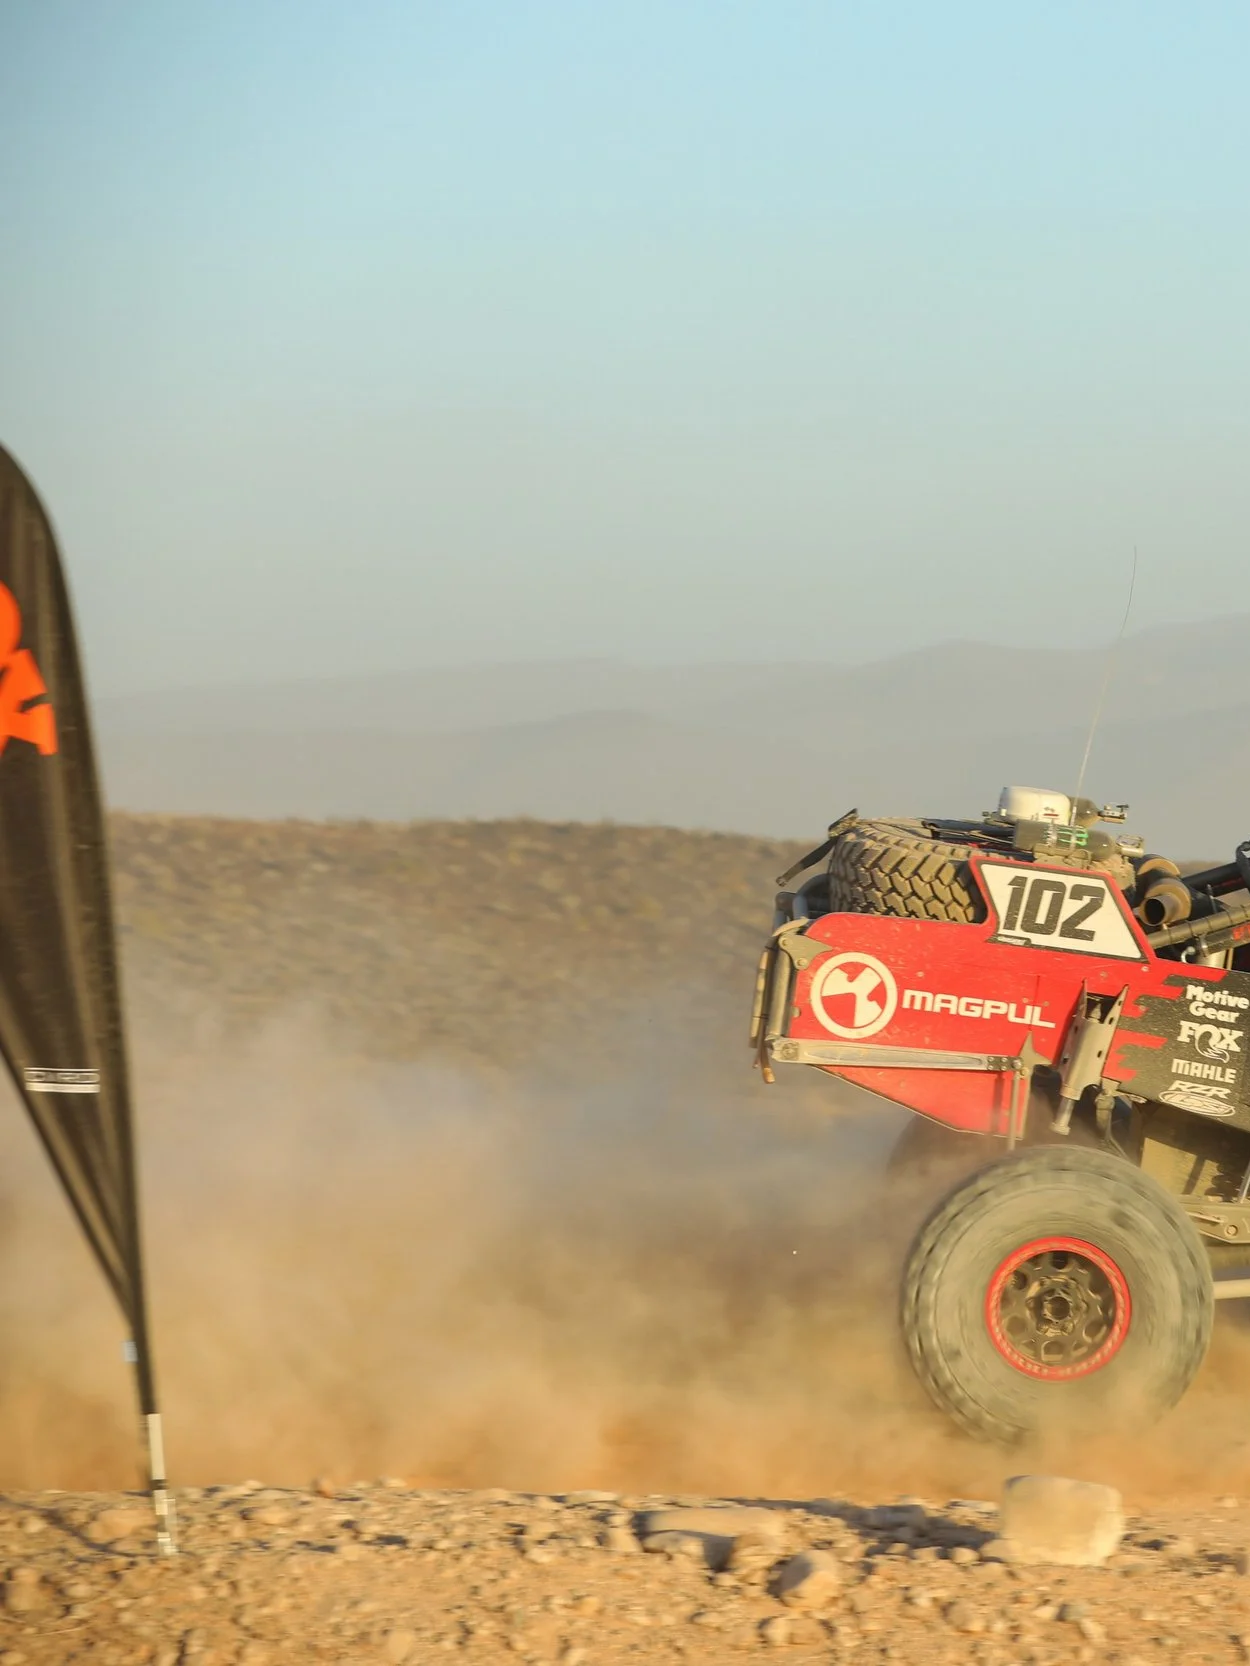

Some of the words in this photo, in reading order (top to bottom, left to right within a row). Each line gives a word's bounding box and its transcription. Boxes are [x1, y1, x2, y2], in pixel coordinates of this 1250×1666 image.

[1003, 875, 1105, 942] 102
[902, 989, 1056, 1028] MAGPUL
[1185, 984, 1250, 1009] Motive
[1189, 1001, 1240, 1023] Gear
[1177, 1020, 1244, 1063] FOX
[1171, 1058, 1237, 1084] MAHLE
[1168, 1080, 1232, 1099] RZR
